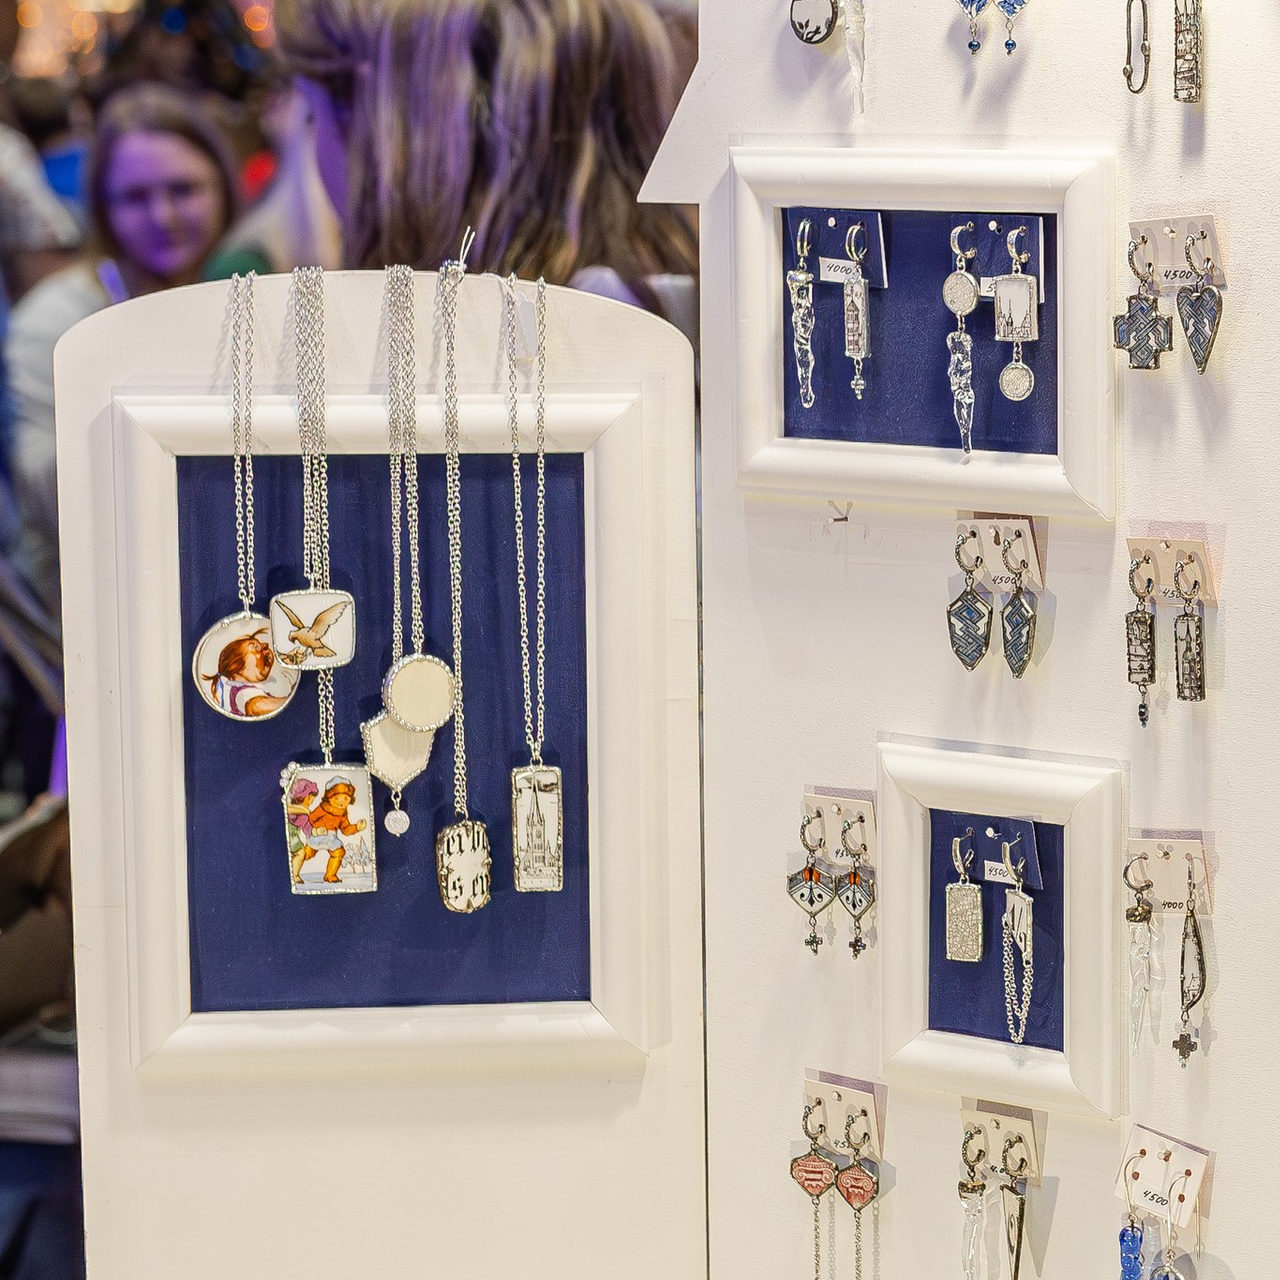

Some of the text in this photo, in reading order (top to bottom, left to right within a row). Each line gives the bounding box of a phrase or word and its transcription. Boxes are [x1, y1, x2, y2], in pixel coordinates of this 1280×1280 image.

[827, 263, 852, 275] 4000
[1163, 269, 1192, 280] 4500
[1161, 899, 1184, 911] 4000
[1142, 1189, 1169, 1206] 4500
